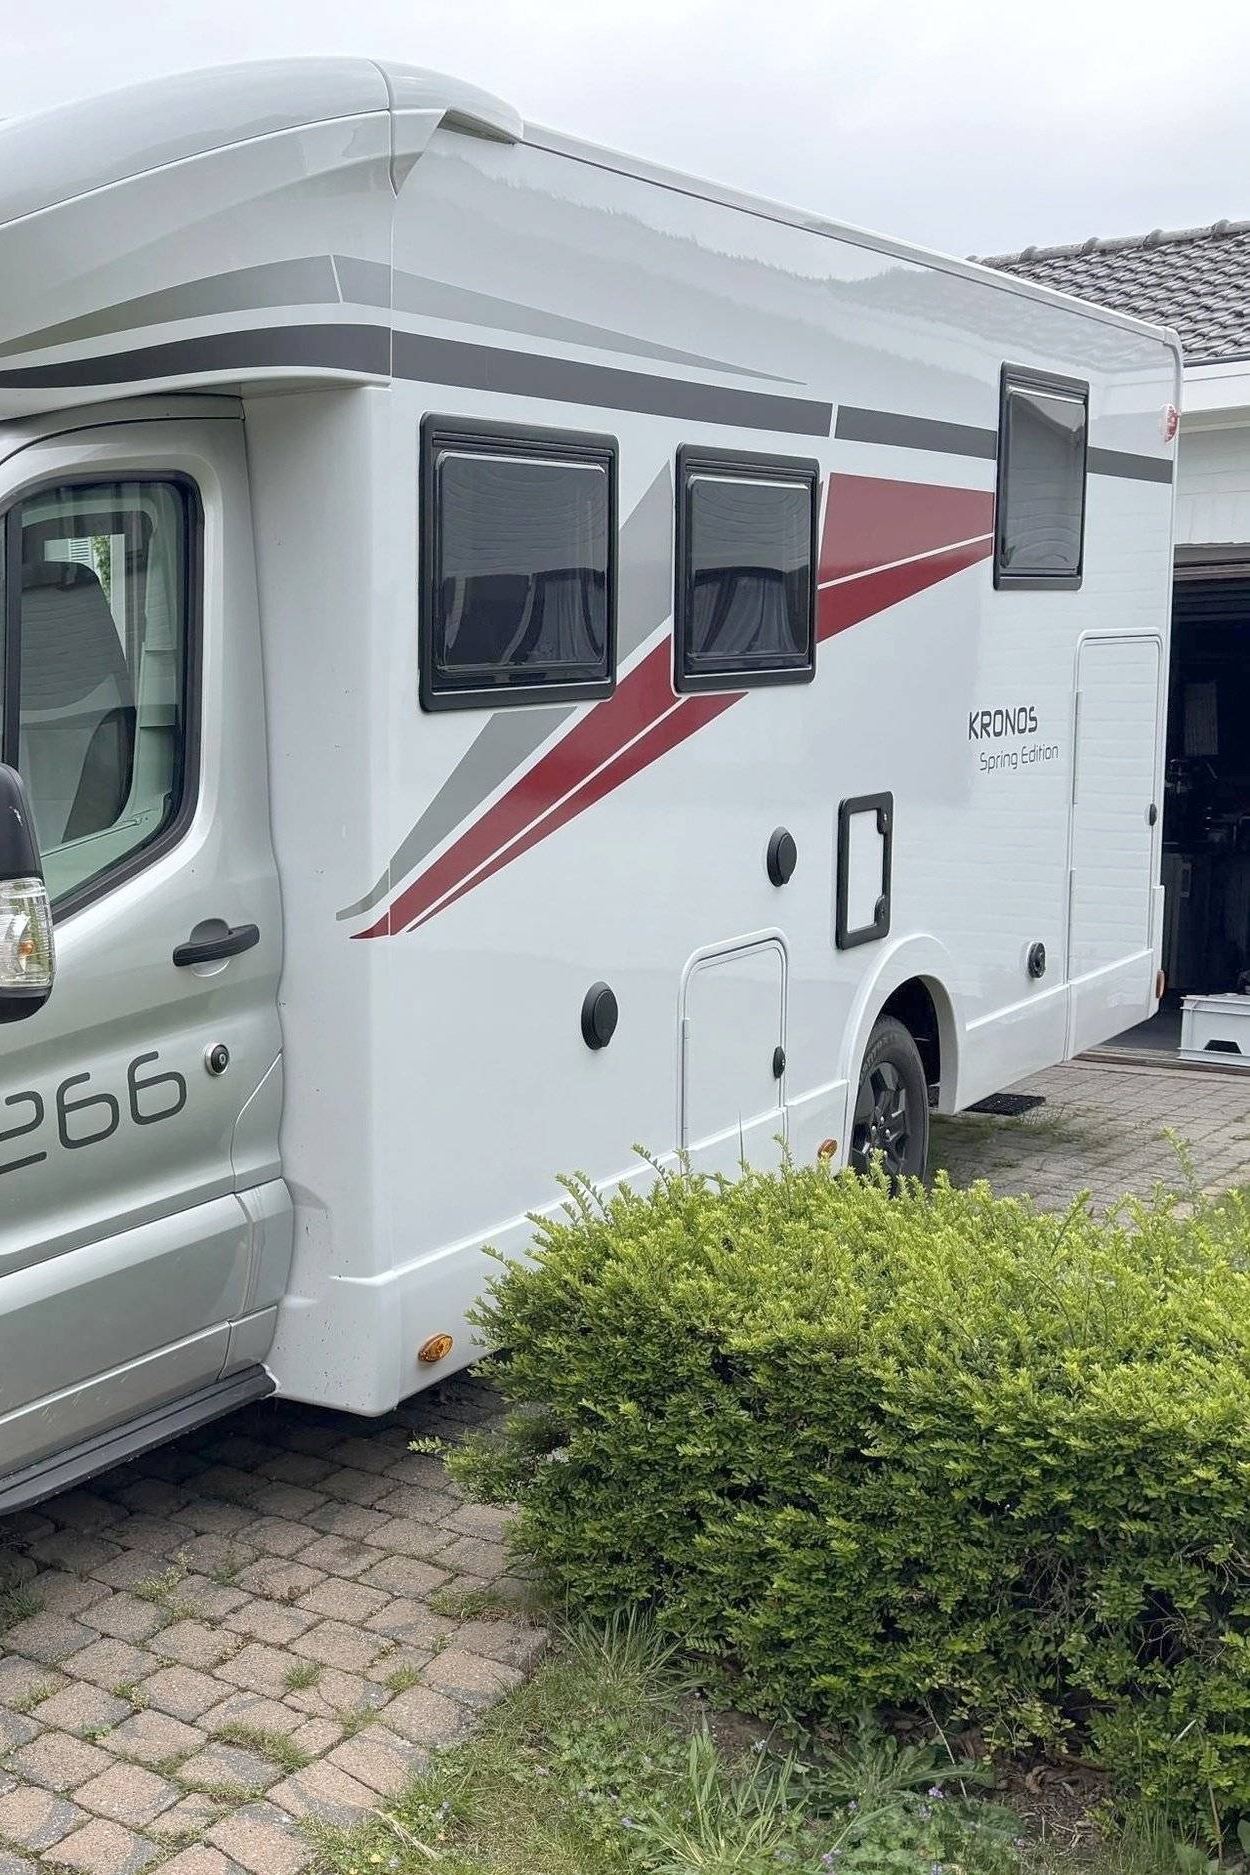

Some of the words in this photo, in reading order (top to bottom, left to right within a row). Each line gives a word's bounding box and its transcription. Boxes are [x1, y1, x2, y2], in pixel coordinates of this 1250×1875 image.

[968, 706, 1038, 740] KRONOS
[979, 751, 1018, 774] Spring
[1021, 744, 1059, 763] Edition
